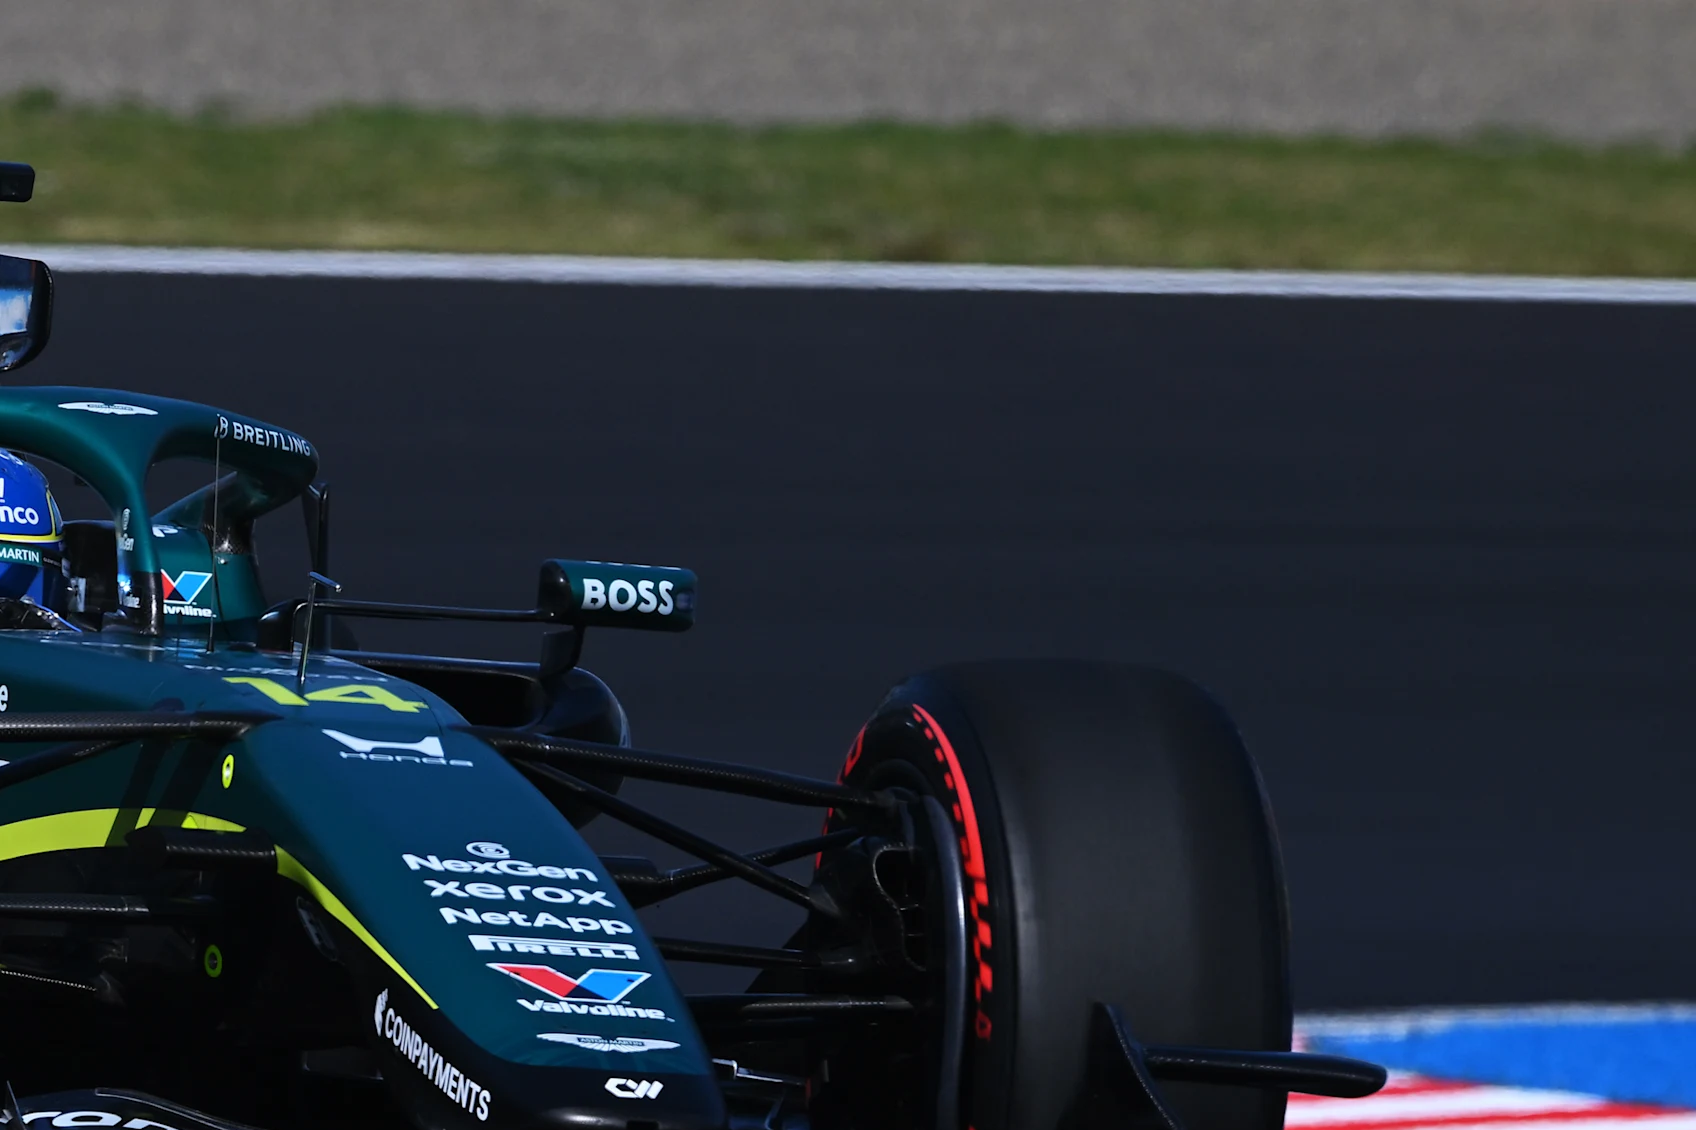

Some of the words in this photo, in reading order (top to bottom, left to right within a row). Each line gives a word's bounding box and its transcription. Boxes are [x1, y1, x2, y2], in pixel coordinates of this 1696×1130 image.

[232, 421, 312, 457] BREITLING
[581, 578, 675, 616] BOSS
[221, 676, 430, 714] 14
[402, 853, 599, 883] NexGen
[423, 879, 617, 909] xerox
[438, 907, 634, 936] NetApp
[467, 934, 641, 961] PIRELLI
[516, 998, 670, 1022] Valvoline
[579, 1037, 608, 1045] ASTON
[608, 1038, 645, 1047] MARTIN
[384, 1007, 492, 1122] COINPAYMENTS
